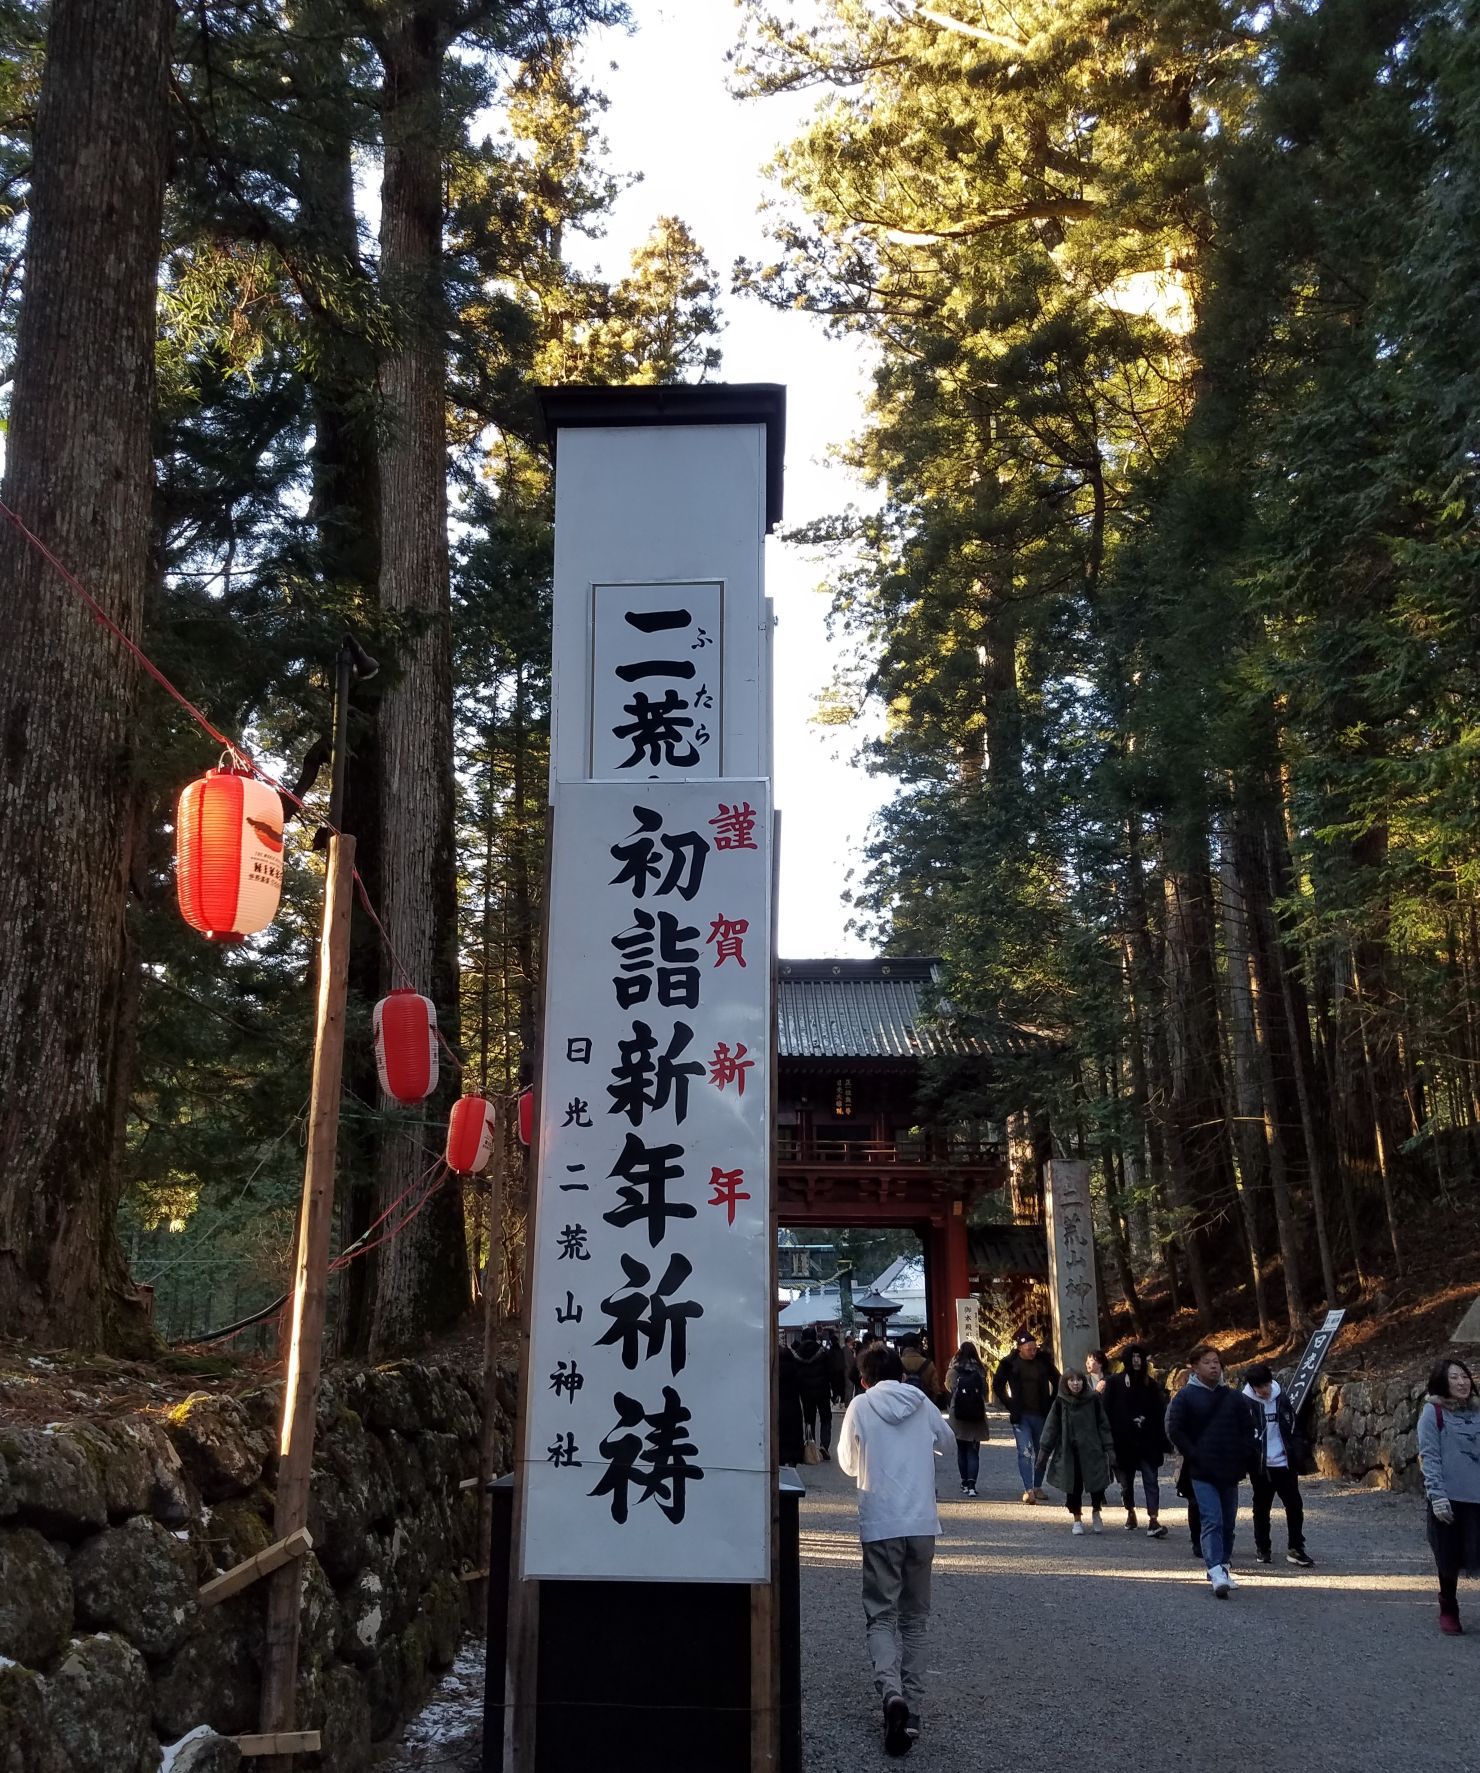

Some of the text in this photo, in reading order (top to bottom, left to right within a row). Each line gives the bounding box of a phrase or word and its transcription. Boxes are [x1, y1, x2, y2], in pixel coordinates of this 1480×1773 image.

[612, 609, 700, 779] 二荒
[691, 627, 713, 746] ふたら
[706, 802, 758, 1226] 謹賀新年
[547, 1036, 593, 1468] 日光二荒山神社
[1060, 1189, 1093, 1334] 二荒山神社
